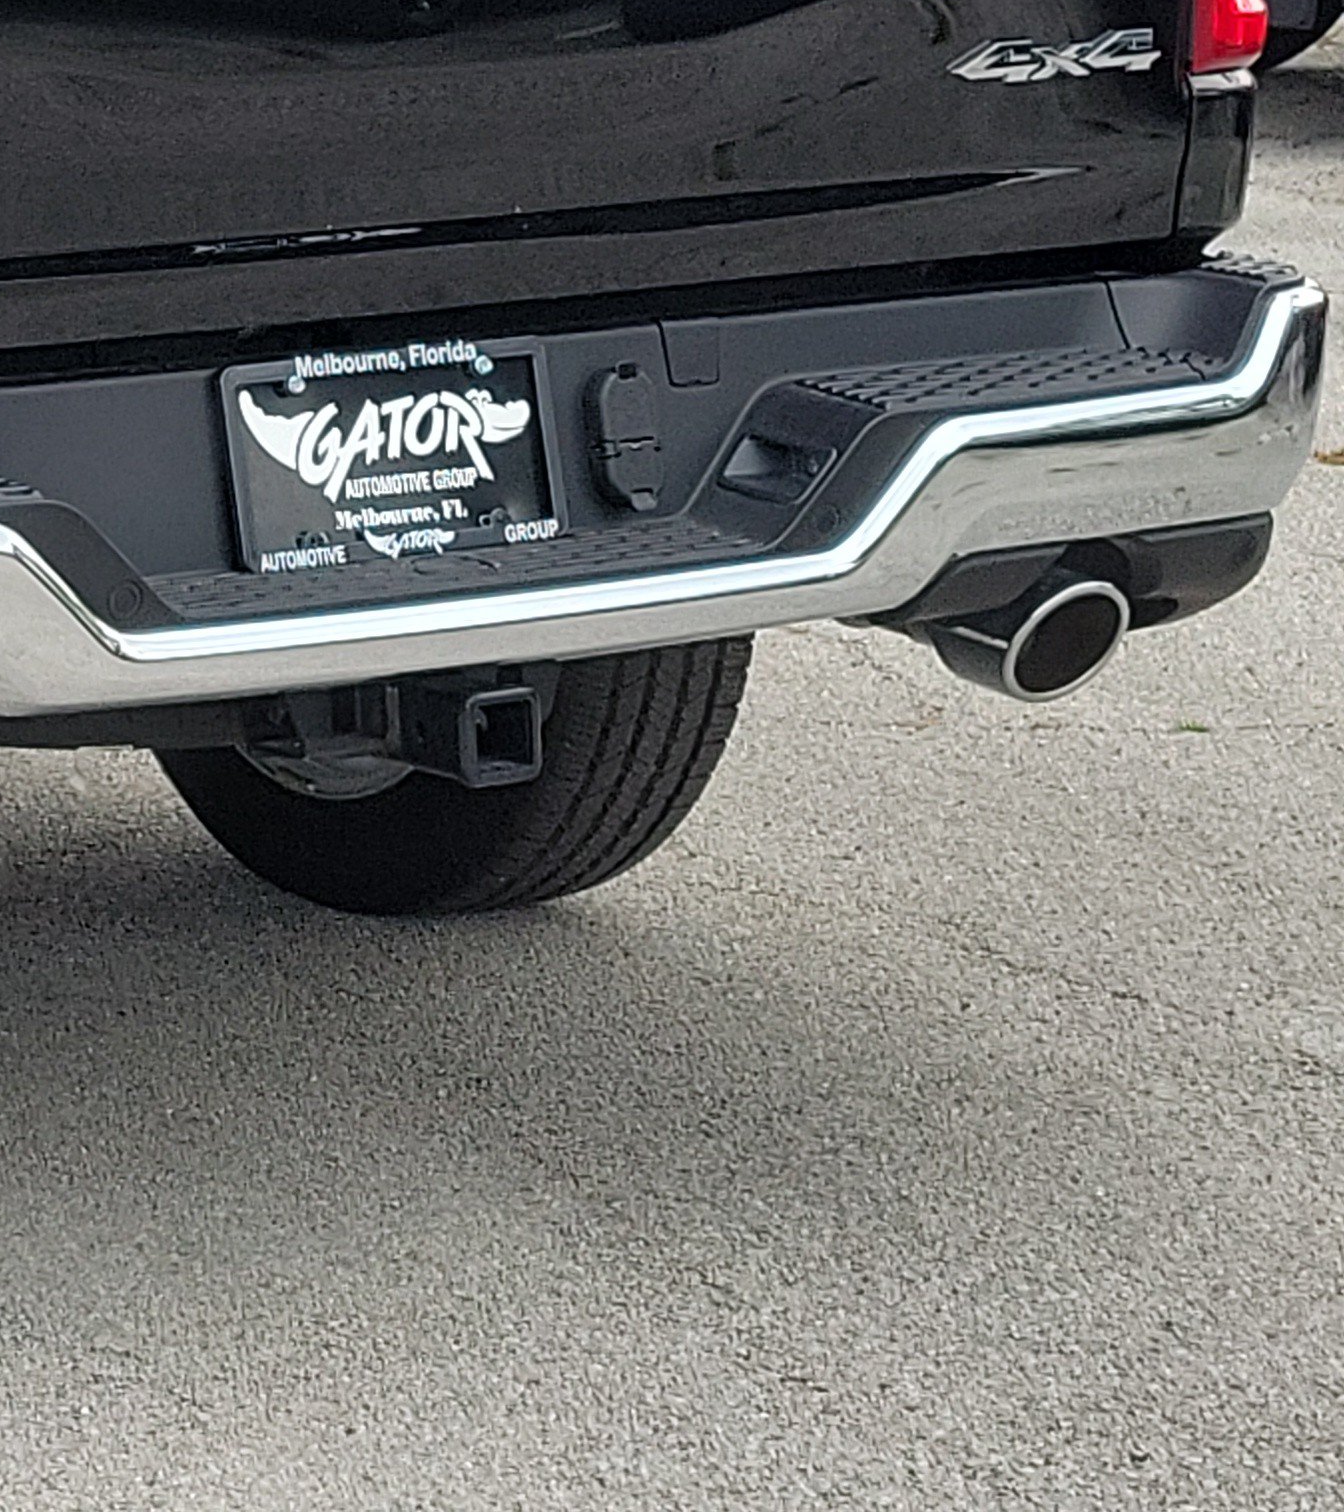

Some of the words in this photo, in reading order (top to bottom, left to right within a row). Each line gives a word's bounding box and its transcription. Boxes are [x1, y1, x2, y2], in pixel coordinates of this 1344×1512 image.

[294, 348, 406, 378] Melbourne,
[409, 340, 477, 368] Florida
[297, 390, 495, 504] GATOR
[345, 471, 430, 500] AUTOMOTIVE
[432, 467, 479, 491] GROUP
[261, 544, 348, 573] AUTOMOTIVE
[382, 528, 446, 560] GATOR
[504, 518, 559, 544] GROUP
